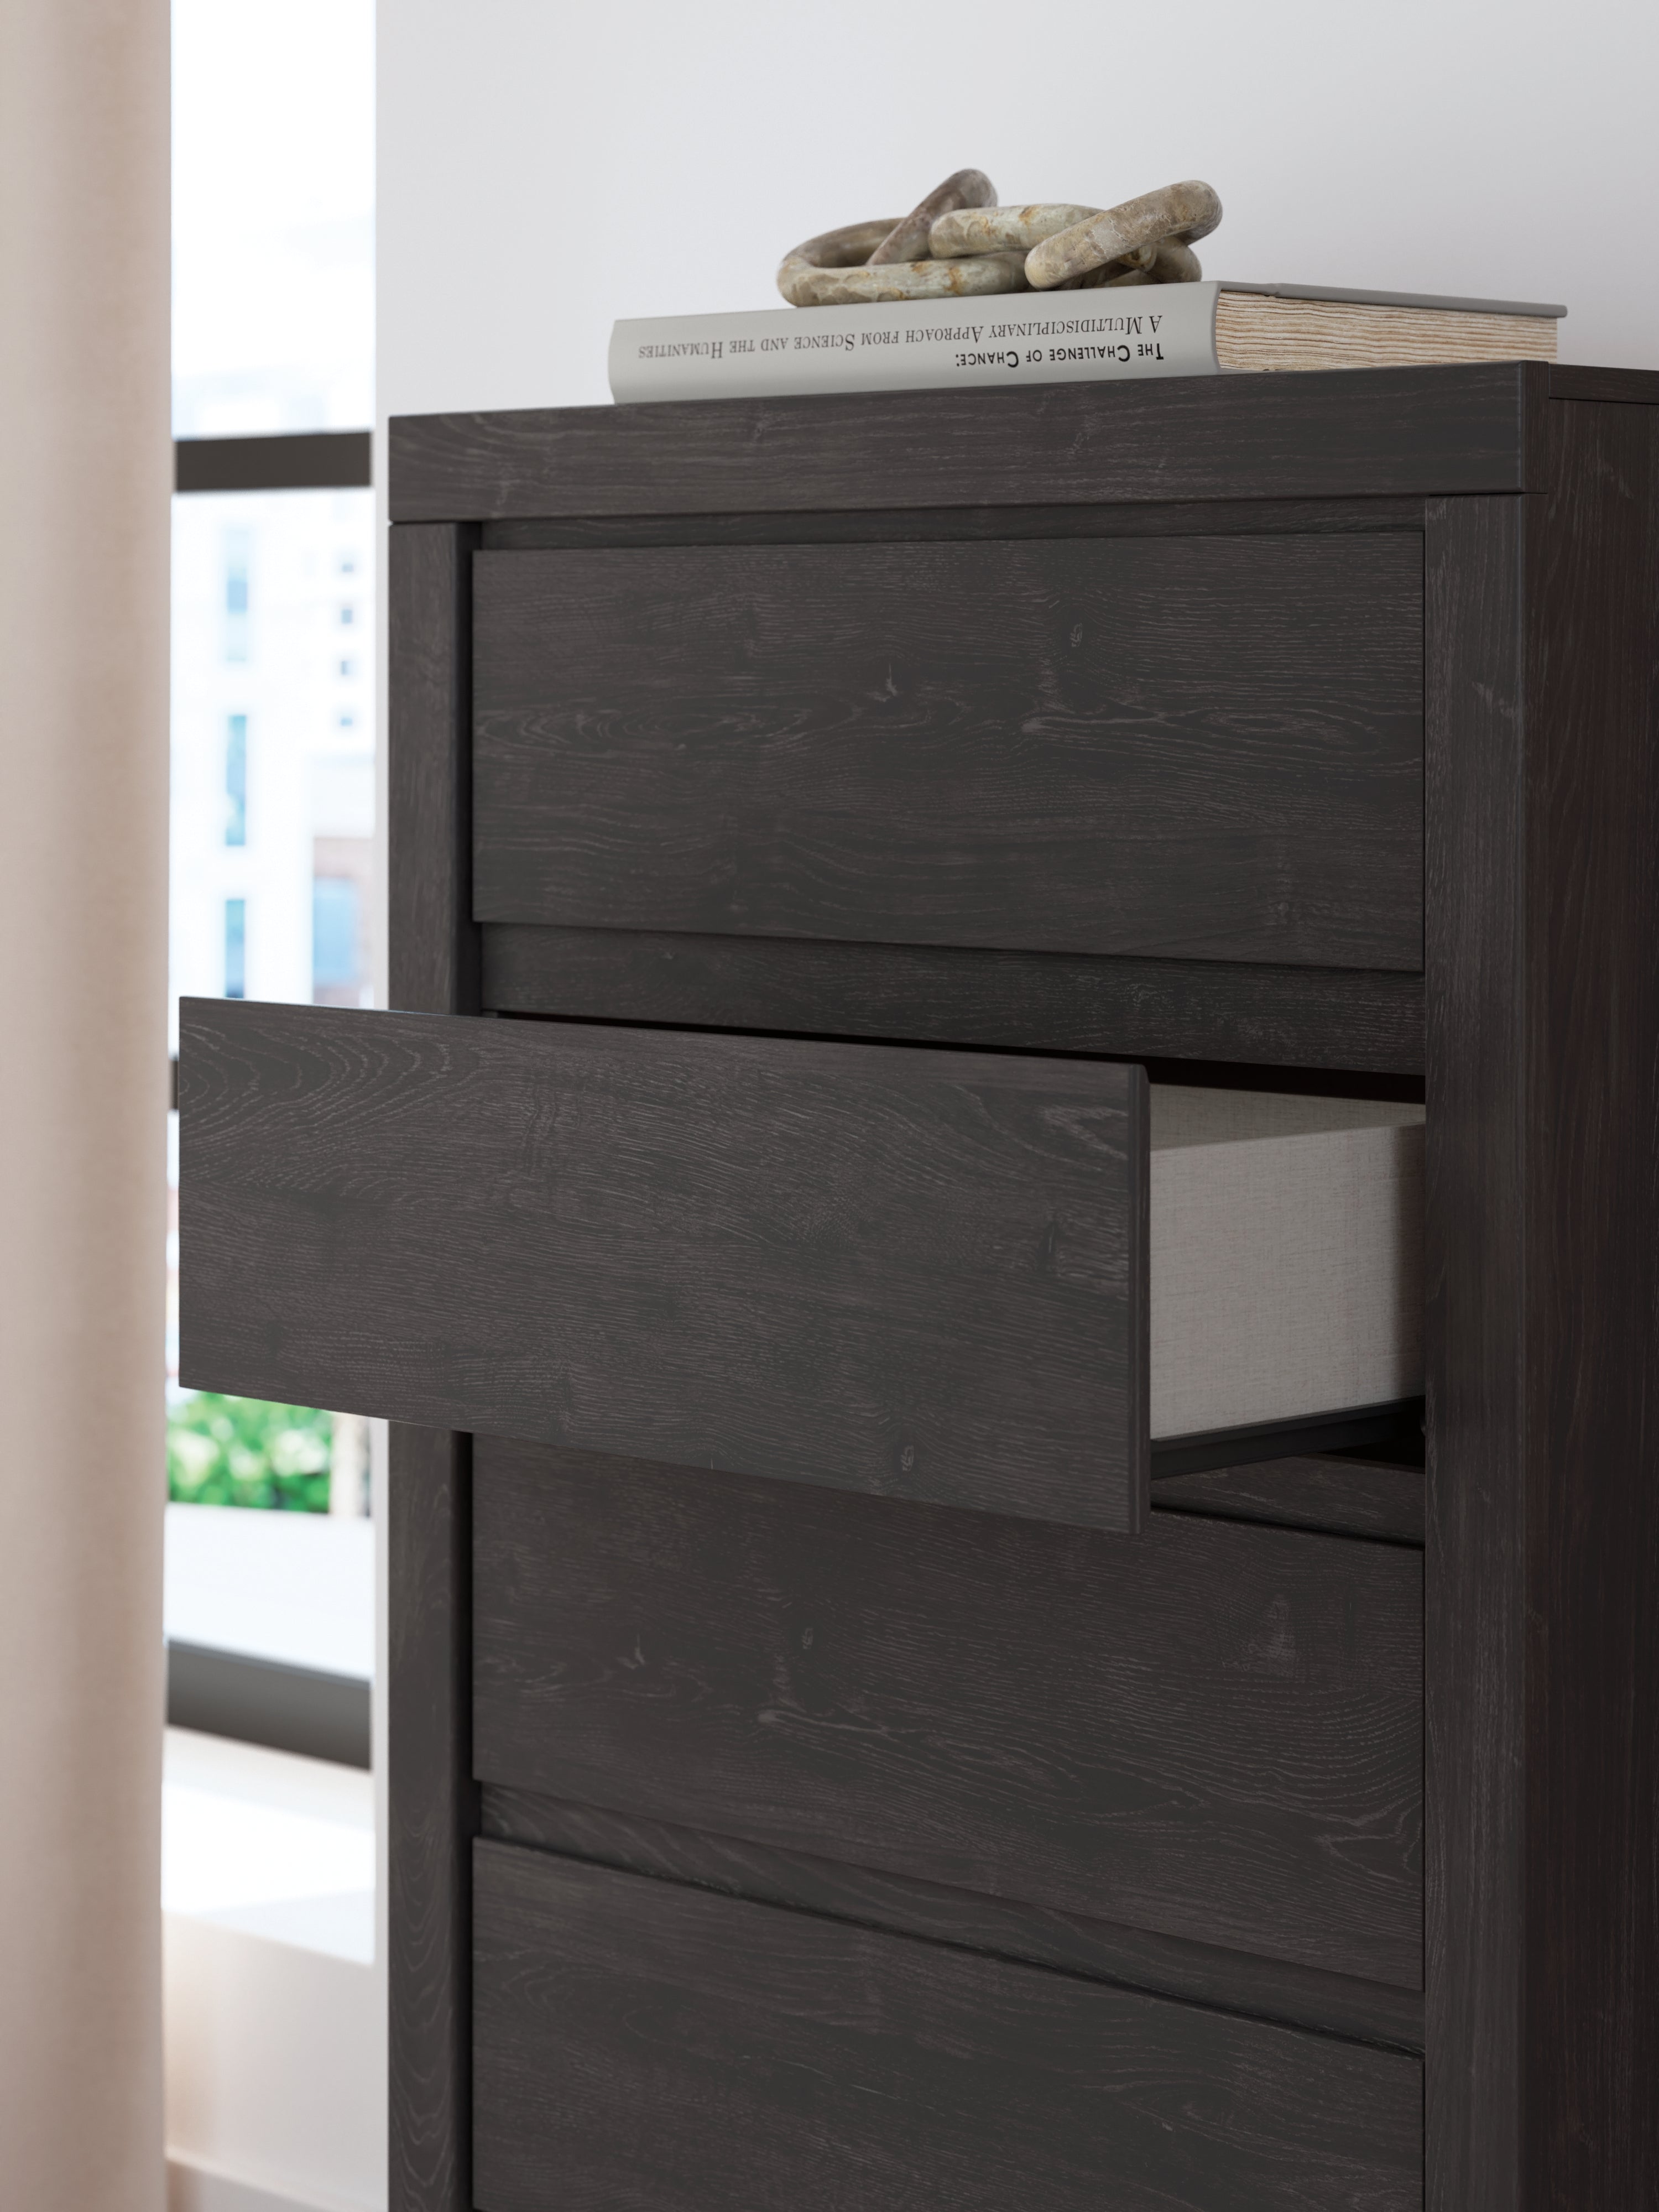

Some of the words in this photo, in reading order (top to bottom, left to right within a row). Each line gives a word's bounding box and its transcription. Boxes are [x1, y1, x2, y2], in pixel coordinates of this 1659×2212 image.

[988, 316, 1143, 338] MULTIDISCIPLINARY
[1149, 315, 1163, 333] A
[794, 333, 855, 351] SCIENCE
[861, 331, 899, 346] FROM
[905, 326, 984, 343] APPROACH
[639, 341, 723, 359] HUMANITIES
[729, 340, 755, 353] THE
[760, 337, 789, 351] AND
[1137, 343, 1164, 361] THE
[955, 351, 1019, 368] CHANCE:
[1025, 349, 1042, 362] OF
[1049, 345, 1131, 363] CHALLENGE
